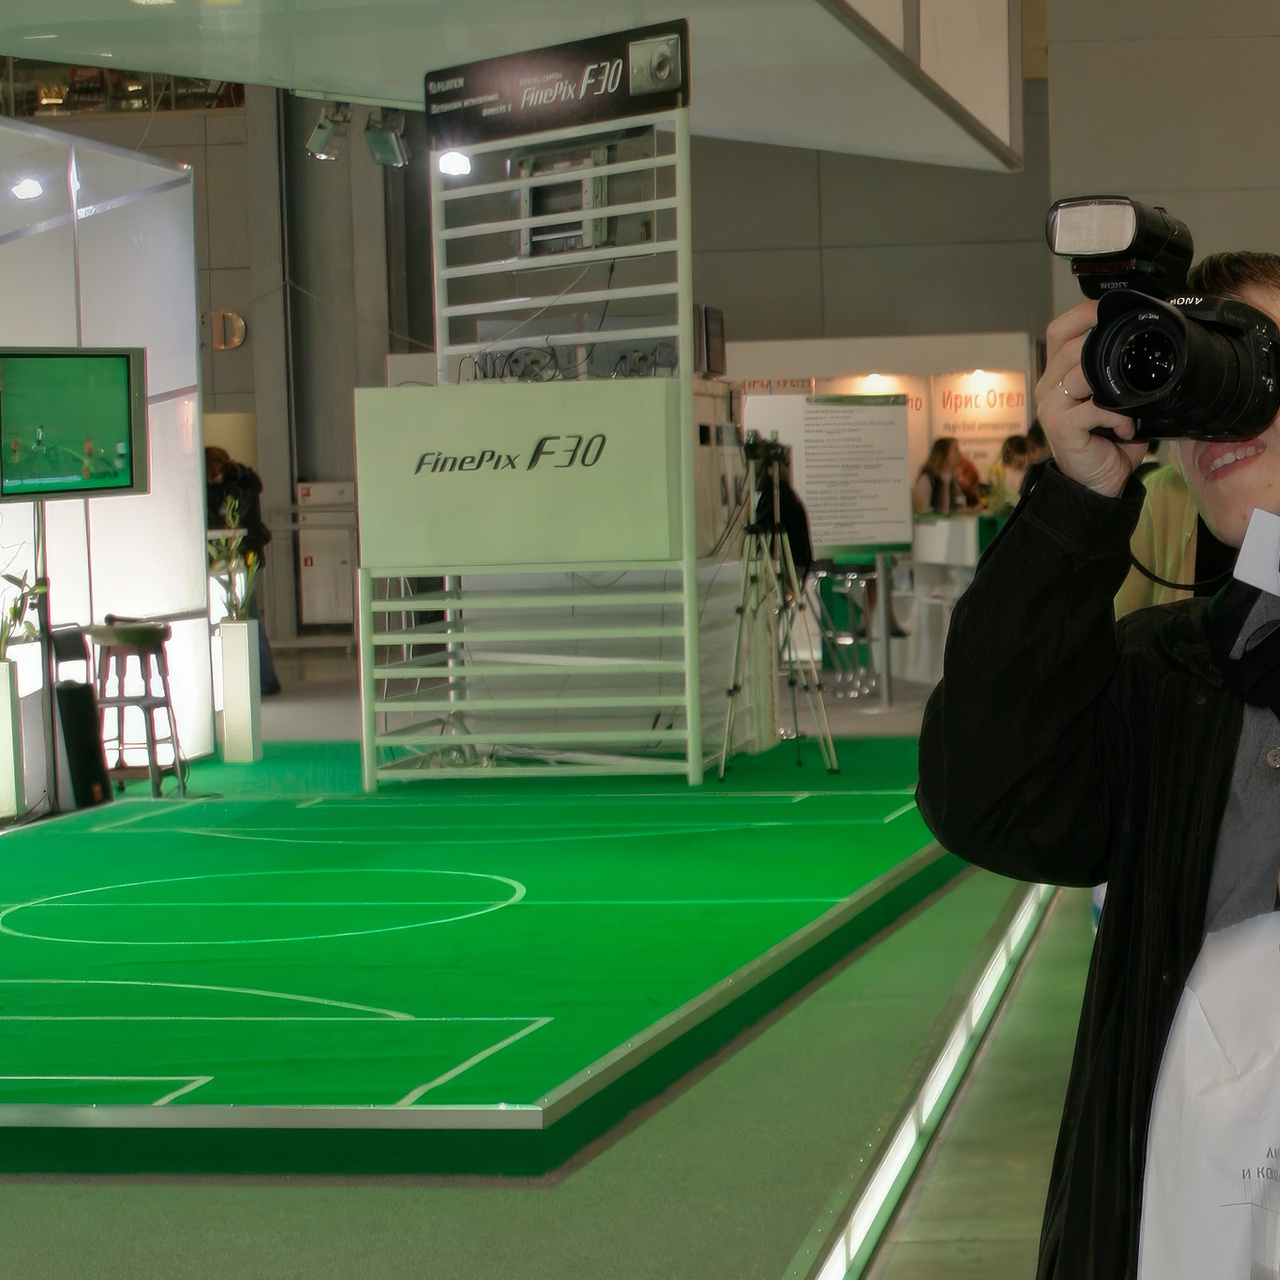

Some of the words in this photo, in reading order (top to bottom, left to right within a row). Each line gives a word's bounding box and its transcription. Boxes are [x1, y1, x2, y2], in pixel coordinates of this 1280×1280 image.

[520, 80, 577, 110] FinePix
[579, 58, 623, 100] F30
[414, 449, 521, 476] FinePix
[526, 433, 607, 472] F30
